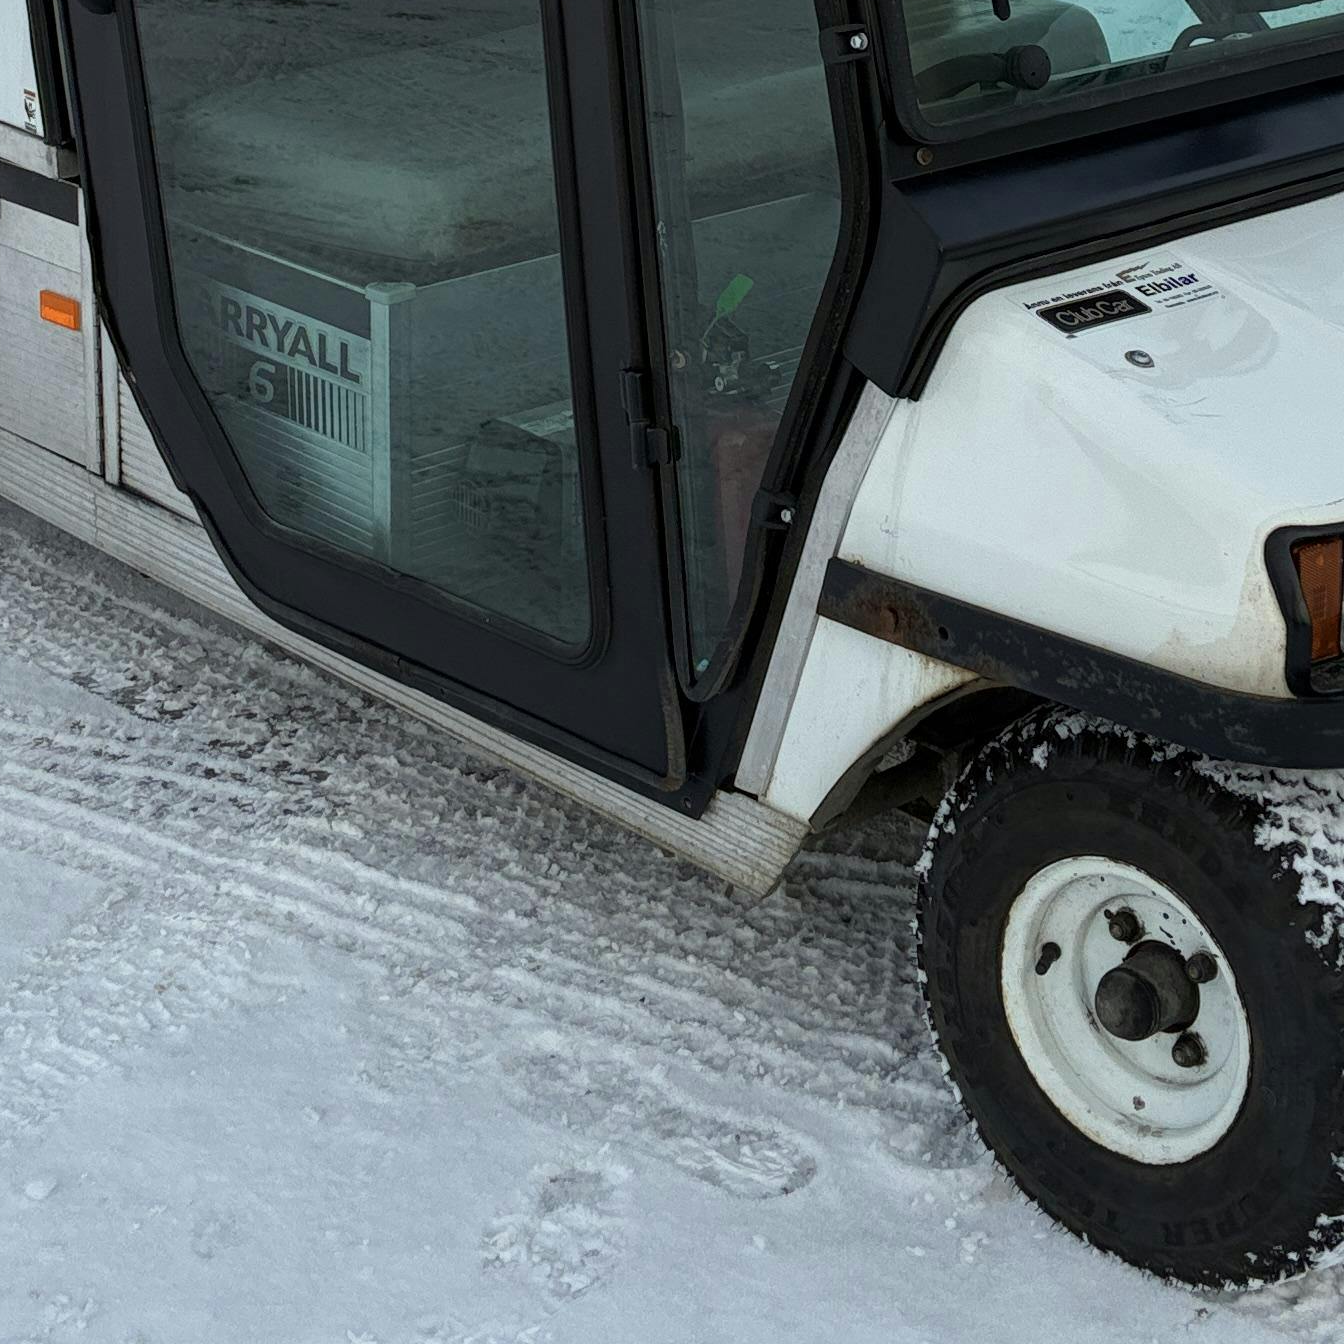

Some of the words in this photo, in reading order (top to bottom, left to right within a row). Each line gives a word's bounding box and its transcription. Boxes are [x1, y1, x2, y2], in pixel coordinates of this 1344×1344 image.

[1134, 272, 1200, 297] Elbilar
[1055, 306, 1105, 326] Club
[1095, 299, 1135, 315] Car
[248, 360, 276, 404] 6
